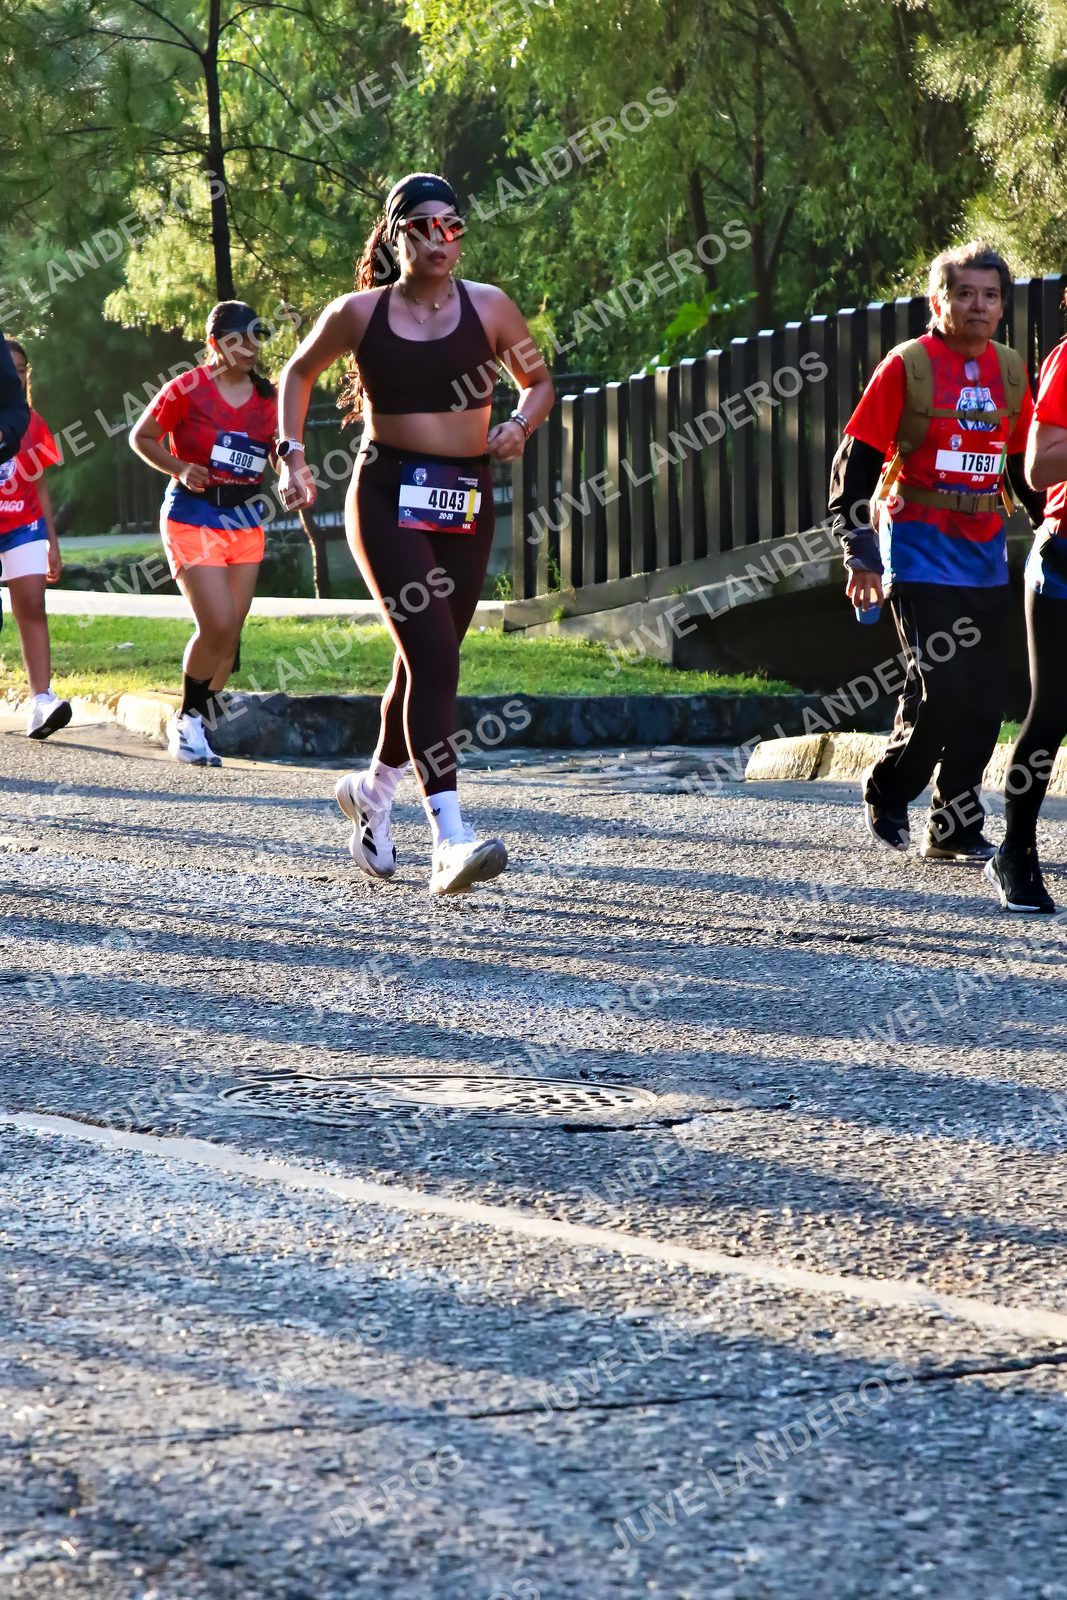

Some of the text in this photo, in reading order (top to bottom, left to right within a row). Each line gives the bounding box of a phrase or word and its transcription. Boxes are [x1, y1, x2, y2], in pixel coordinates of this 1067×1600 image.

[229, 451, 254, 468] 4808
[962, 453, 996, 472] 17631
[428, 489, 466, 511] 4043
